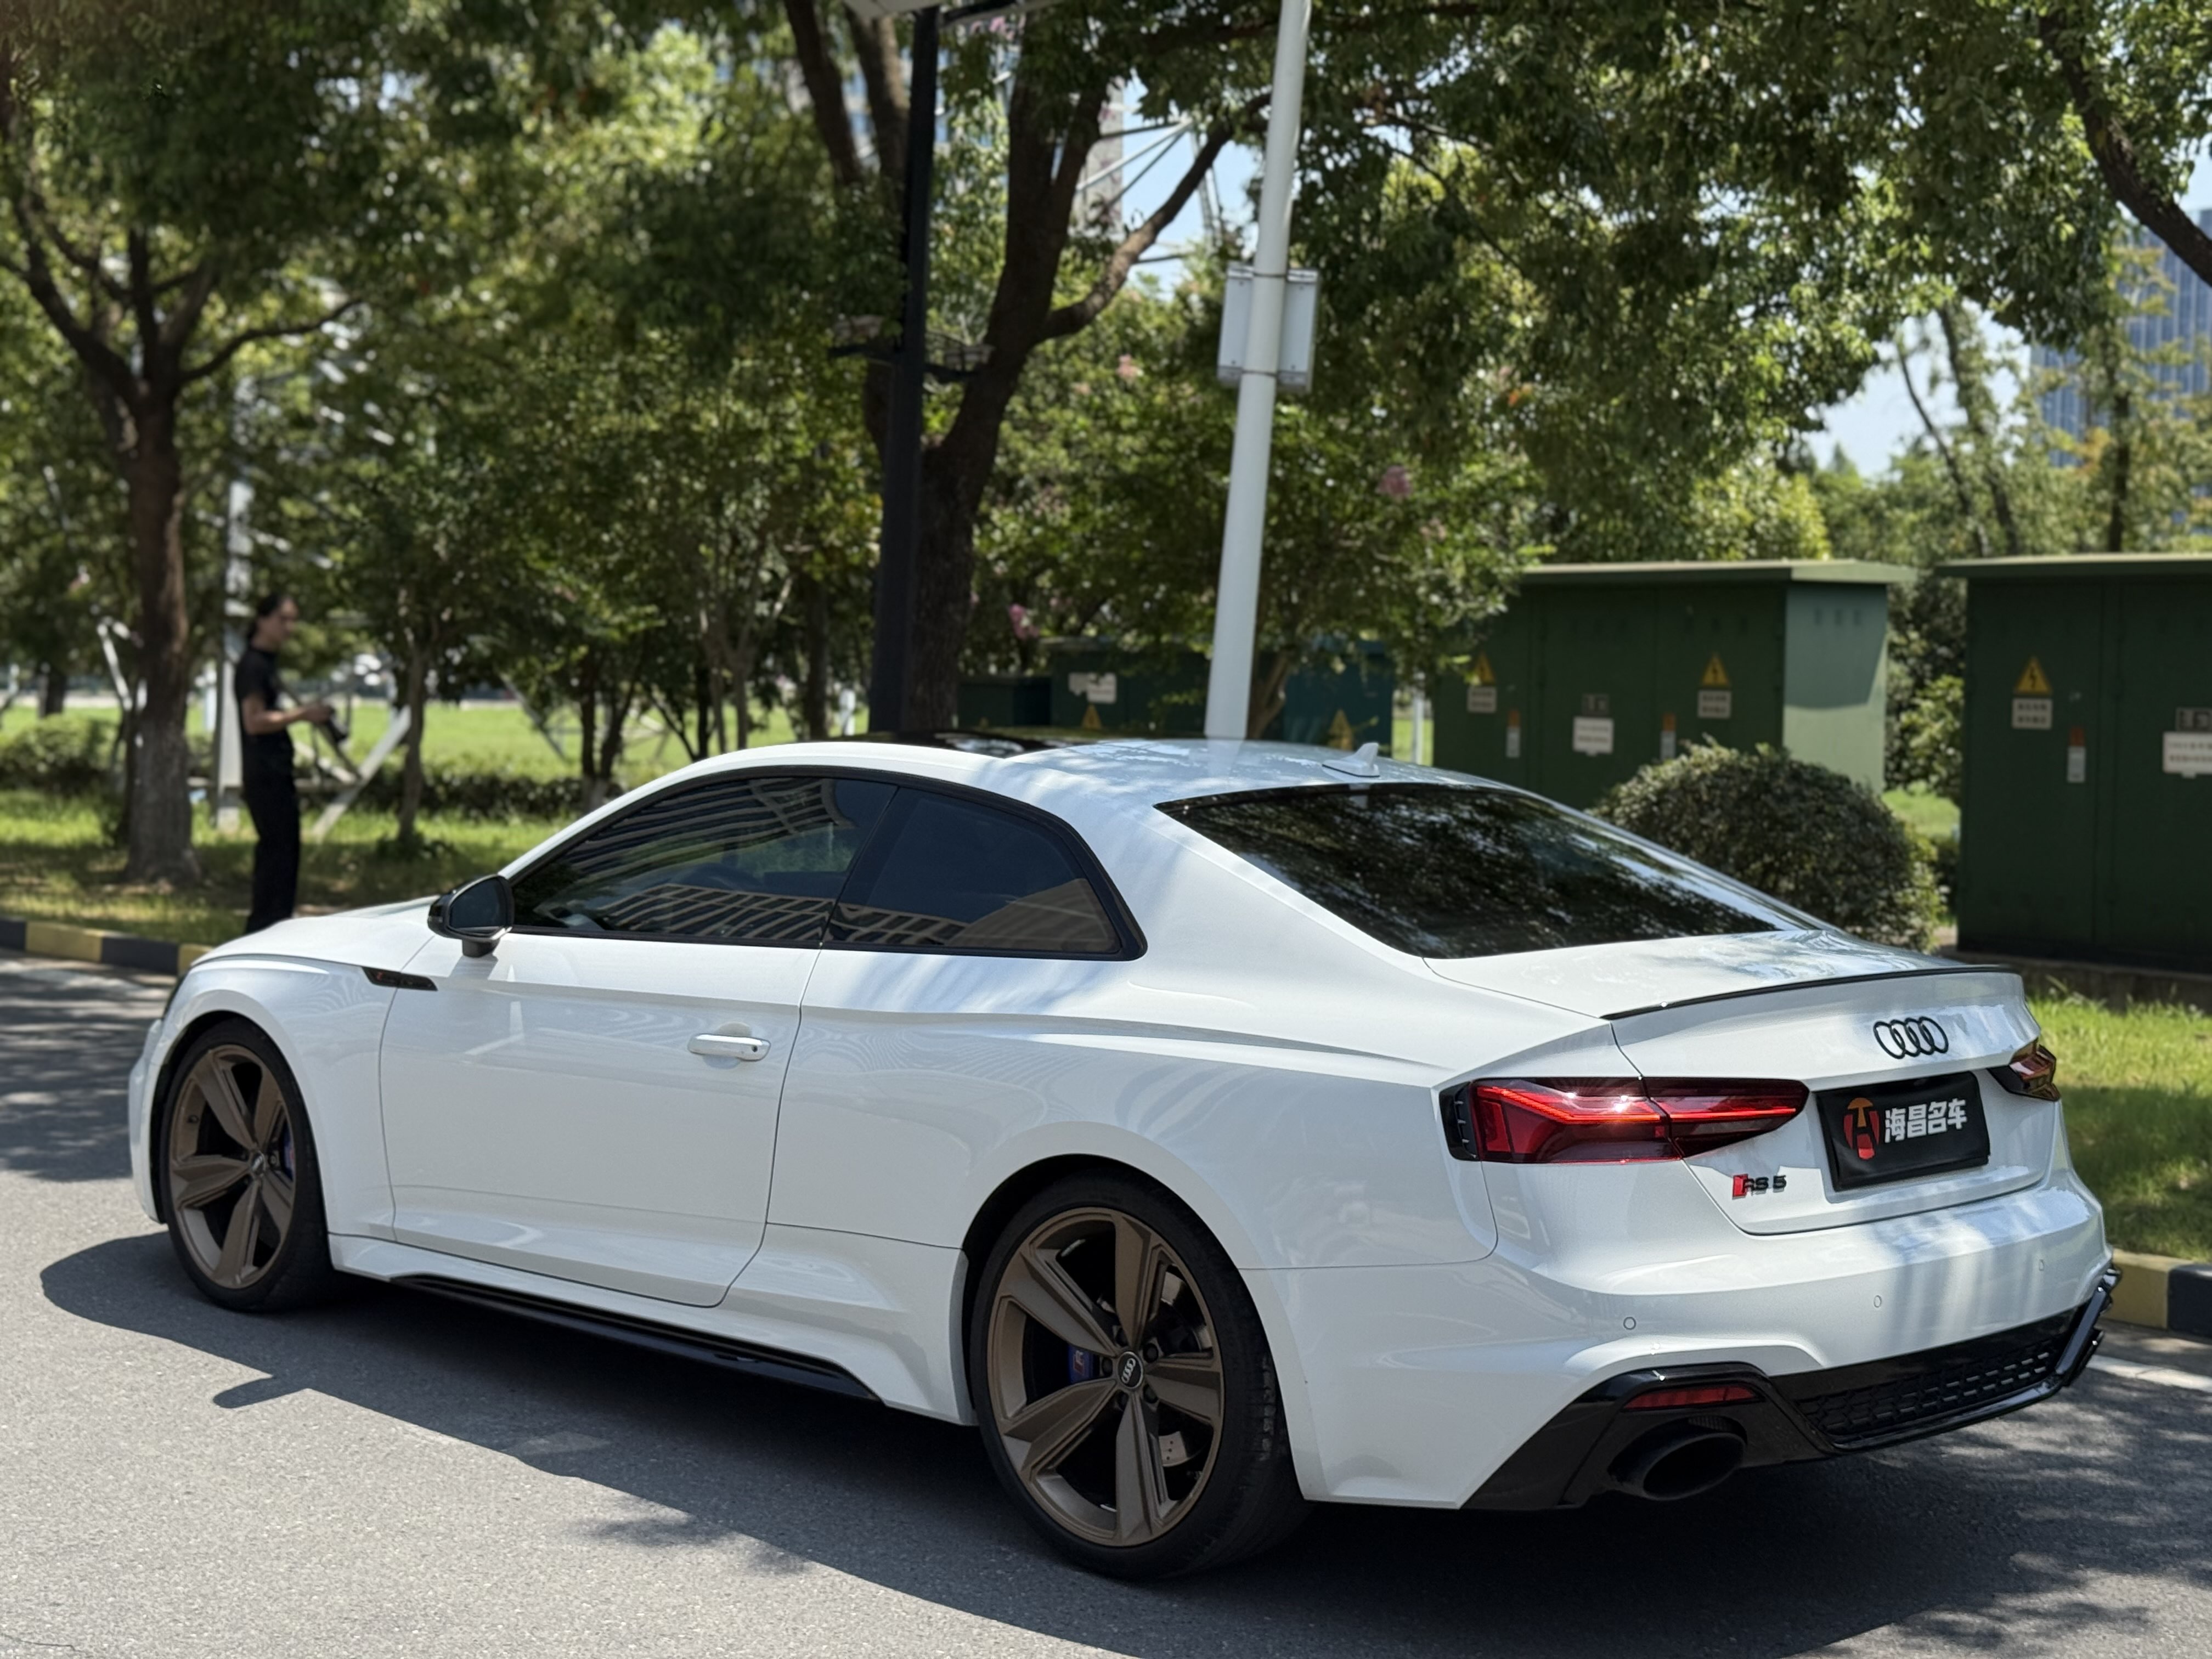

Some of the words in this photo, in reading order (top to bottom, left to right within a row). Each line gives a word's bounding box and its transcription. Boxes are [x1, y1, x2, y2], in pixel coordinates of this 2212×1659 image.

[1884, 1098, 1967, 1143] 海昌名车
[1740, 1176, 1769, 1191] RS
[1773, 1175, 1787, 1189] 5
